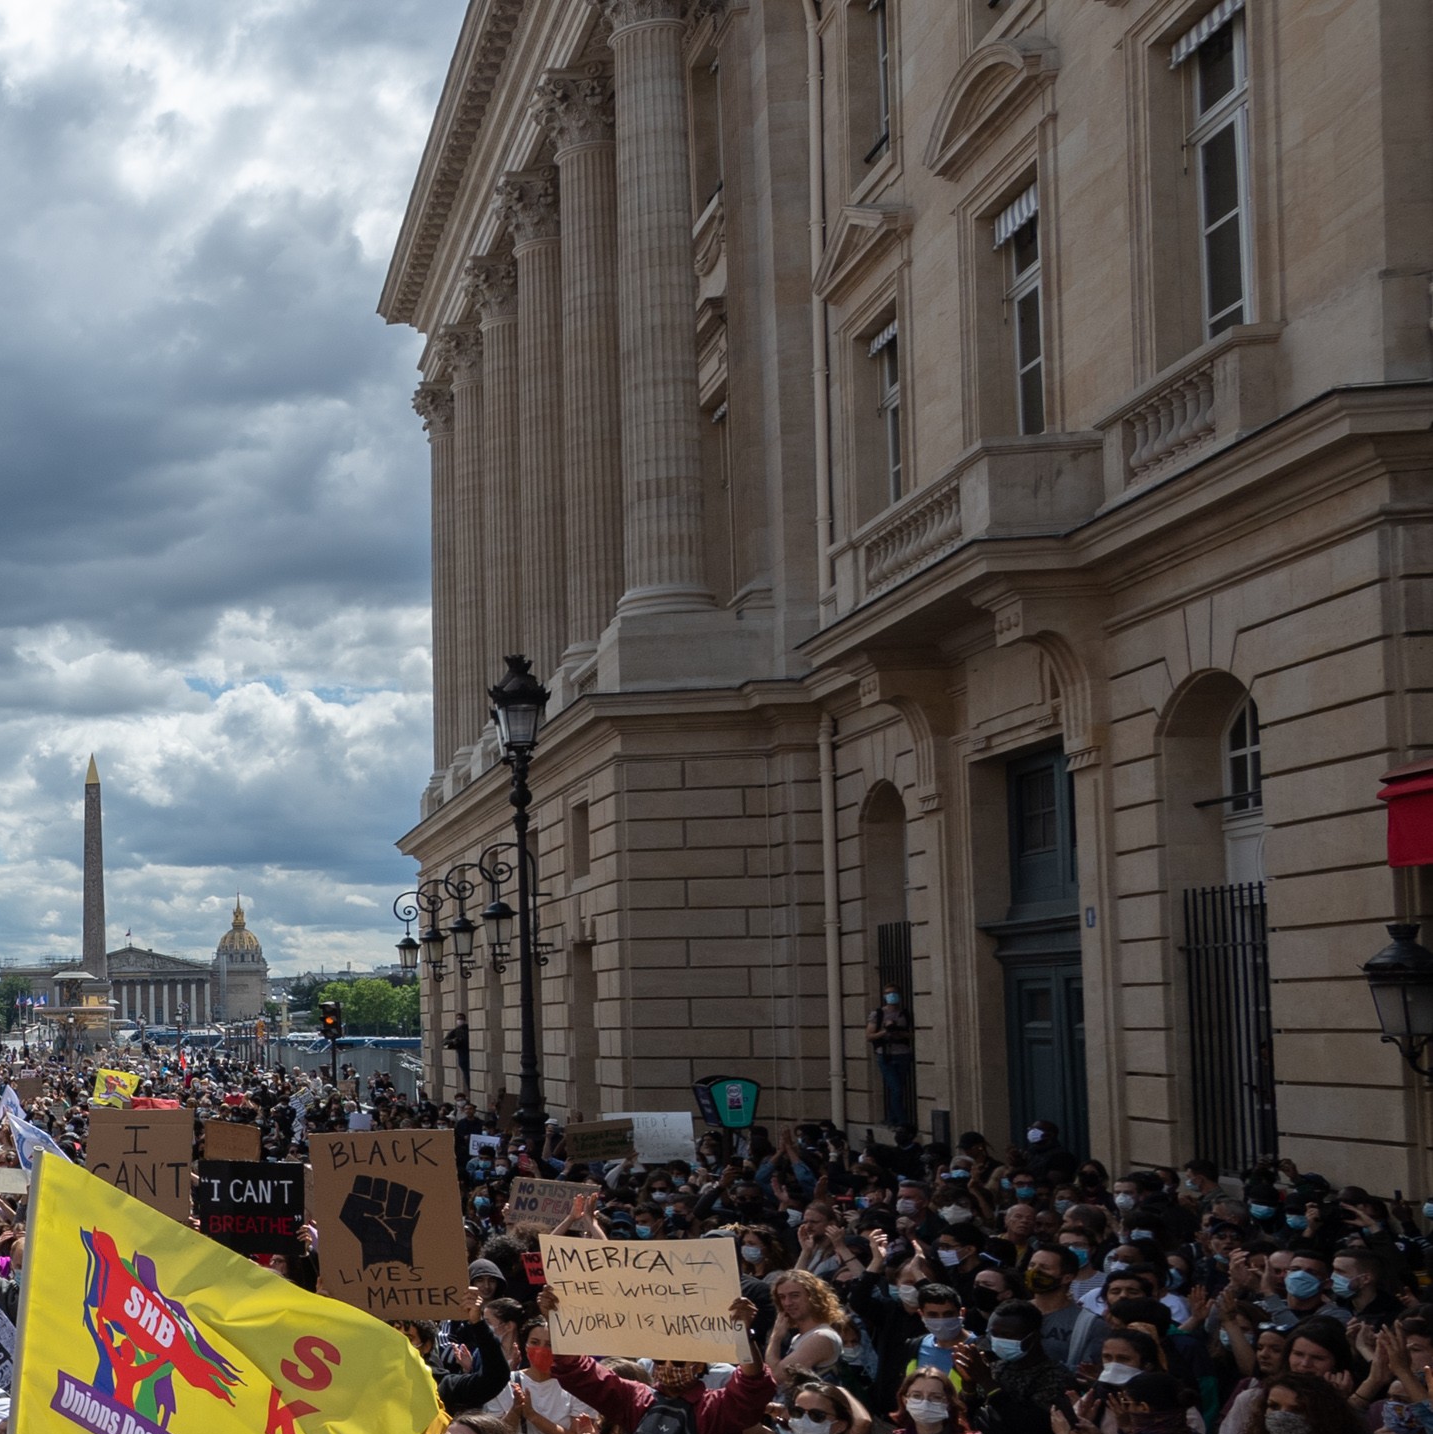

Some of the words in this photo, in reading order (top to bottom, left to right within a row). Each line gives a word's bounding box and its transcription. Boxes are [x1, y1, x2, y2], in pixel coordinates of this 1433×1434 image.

[123, 1125, 150, 1155] I
[328, 1137, 439, 1171] BLACK
[229, 1179, 293, 1204] CAN'T
[514, 1196, 539, 1212] NO
[546, 1245, 674, 1276] AMERICA
[339, 1265, 426, 1285] LIVES
[367, 1285, 461, 1309] MATTER
[553, 1280, 603, 1297] THE
[618, 1280, 699, 1298] WHOLE
[123, 1285, 176, 1349] SKB
[554, 1311, 626, 1337] WORLD
[661, 1314, 744, 1337] WATCHING
